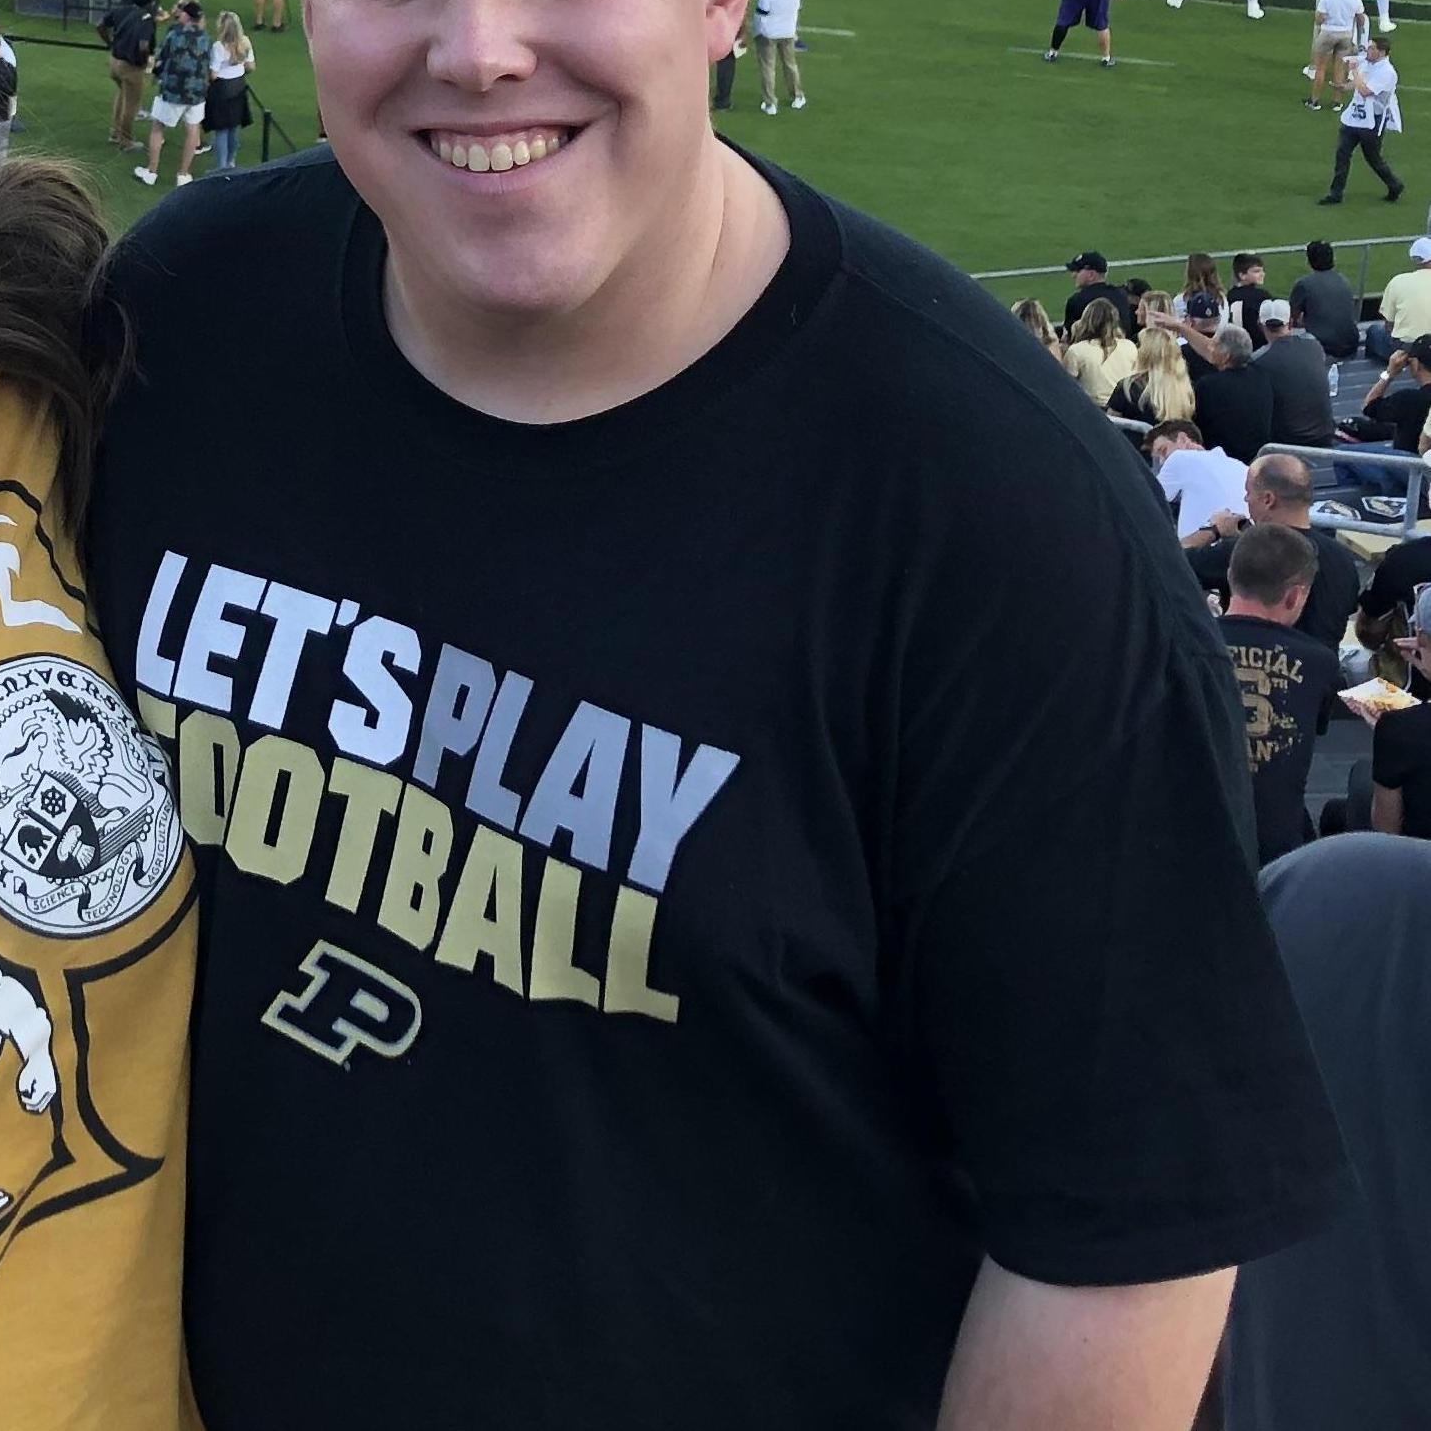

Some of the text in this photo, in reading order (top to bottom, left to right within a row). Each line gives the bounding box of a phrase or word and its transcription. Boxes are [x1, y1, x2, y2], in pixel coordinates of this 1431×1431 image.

[135, 550, 740, 893] LET'S PLAY
[148, 799, 173, 884] AGRICULTUR
[33, 885, 78, 911] SCIENCE
[85, 846, 135, 920] TECHNOLOGY
